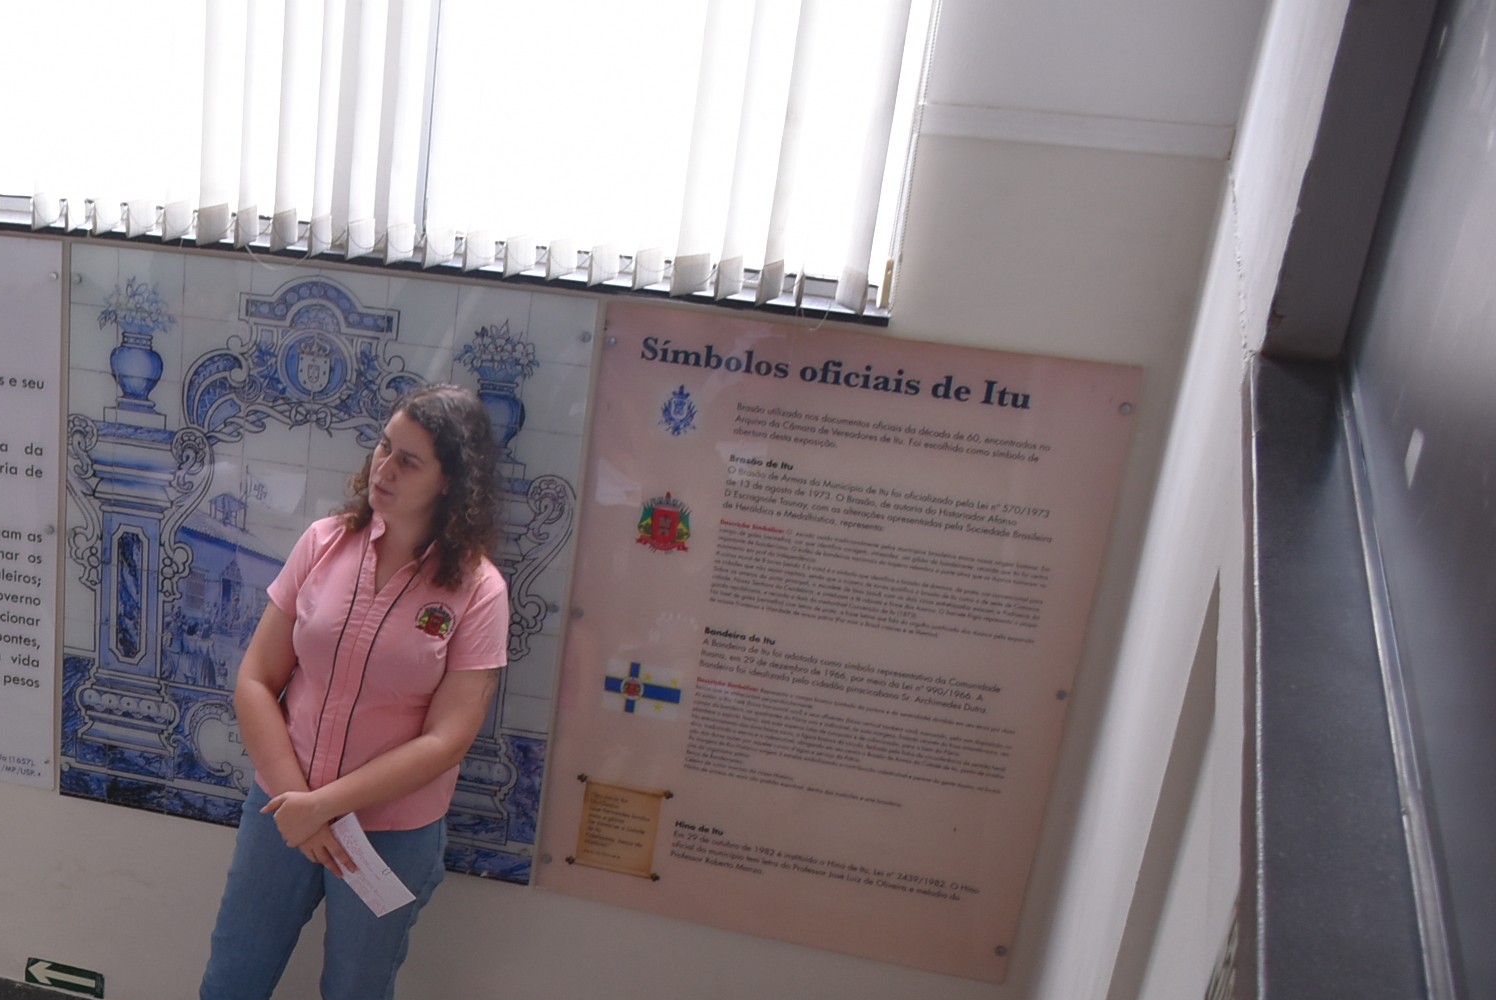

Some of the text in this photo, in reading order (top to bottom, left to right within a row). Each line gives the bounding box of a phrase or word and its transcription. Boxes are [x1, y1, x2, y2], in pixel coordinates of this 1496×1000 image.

[641, 335, 1031, 410] Símbolos oficiais de Itu
[9, 378, 17, 387] e
[21, 380, 45, 390] seu
[733, 426, 767, 438] abertura
[769, 431, 791, 442] desta
[736, 403, 765, 414] Brasão
[767, 407, 803, 419] utilizado
[821, 414, 870, 428] documentos
[872, 421, 902, 432] oficiais
[904, 425, 916, 434] da
[918, 427, 951, 439] década
[954, 431, 964, 441] de
[966, 433, 982, 445] 60,
[984, 437, 1036, 450] encontrados
[1039, 444, 1051, 452] no
[734, 414, 767, 426] Arquivo
[768, 419, 780, 428] da
[782, 421, 816, 433] Câmara
[818, 425, 829, 435] de
[832, 427, 877, 441] Vereadores
[879, 434, 891, 443] de
[908, 437, 921, 447] Foi
[924, 442, 964, 453] escolhido
[966, 447, 990, 456] como
[992, 450, 1025, 461] símbolo
[1027, 453, 1039, 463] de
[24, 442, 43, 456] da
[729, 454, 794, 471] Brasão de Itu
[25, 464, 43, 478] de
[27, 533, 42, 543] as
[28, 555, 42, 564] os
[704, 627, 776, 645] Bandeira de Itu
[11, 654, 40, 668] vida
[3, 675, 40, 688] pesos
[675, 820, 724, 836] Hino de Itu
